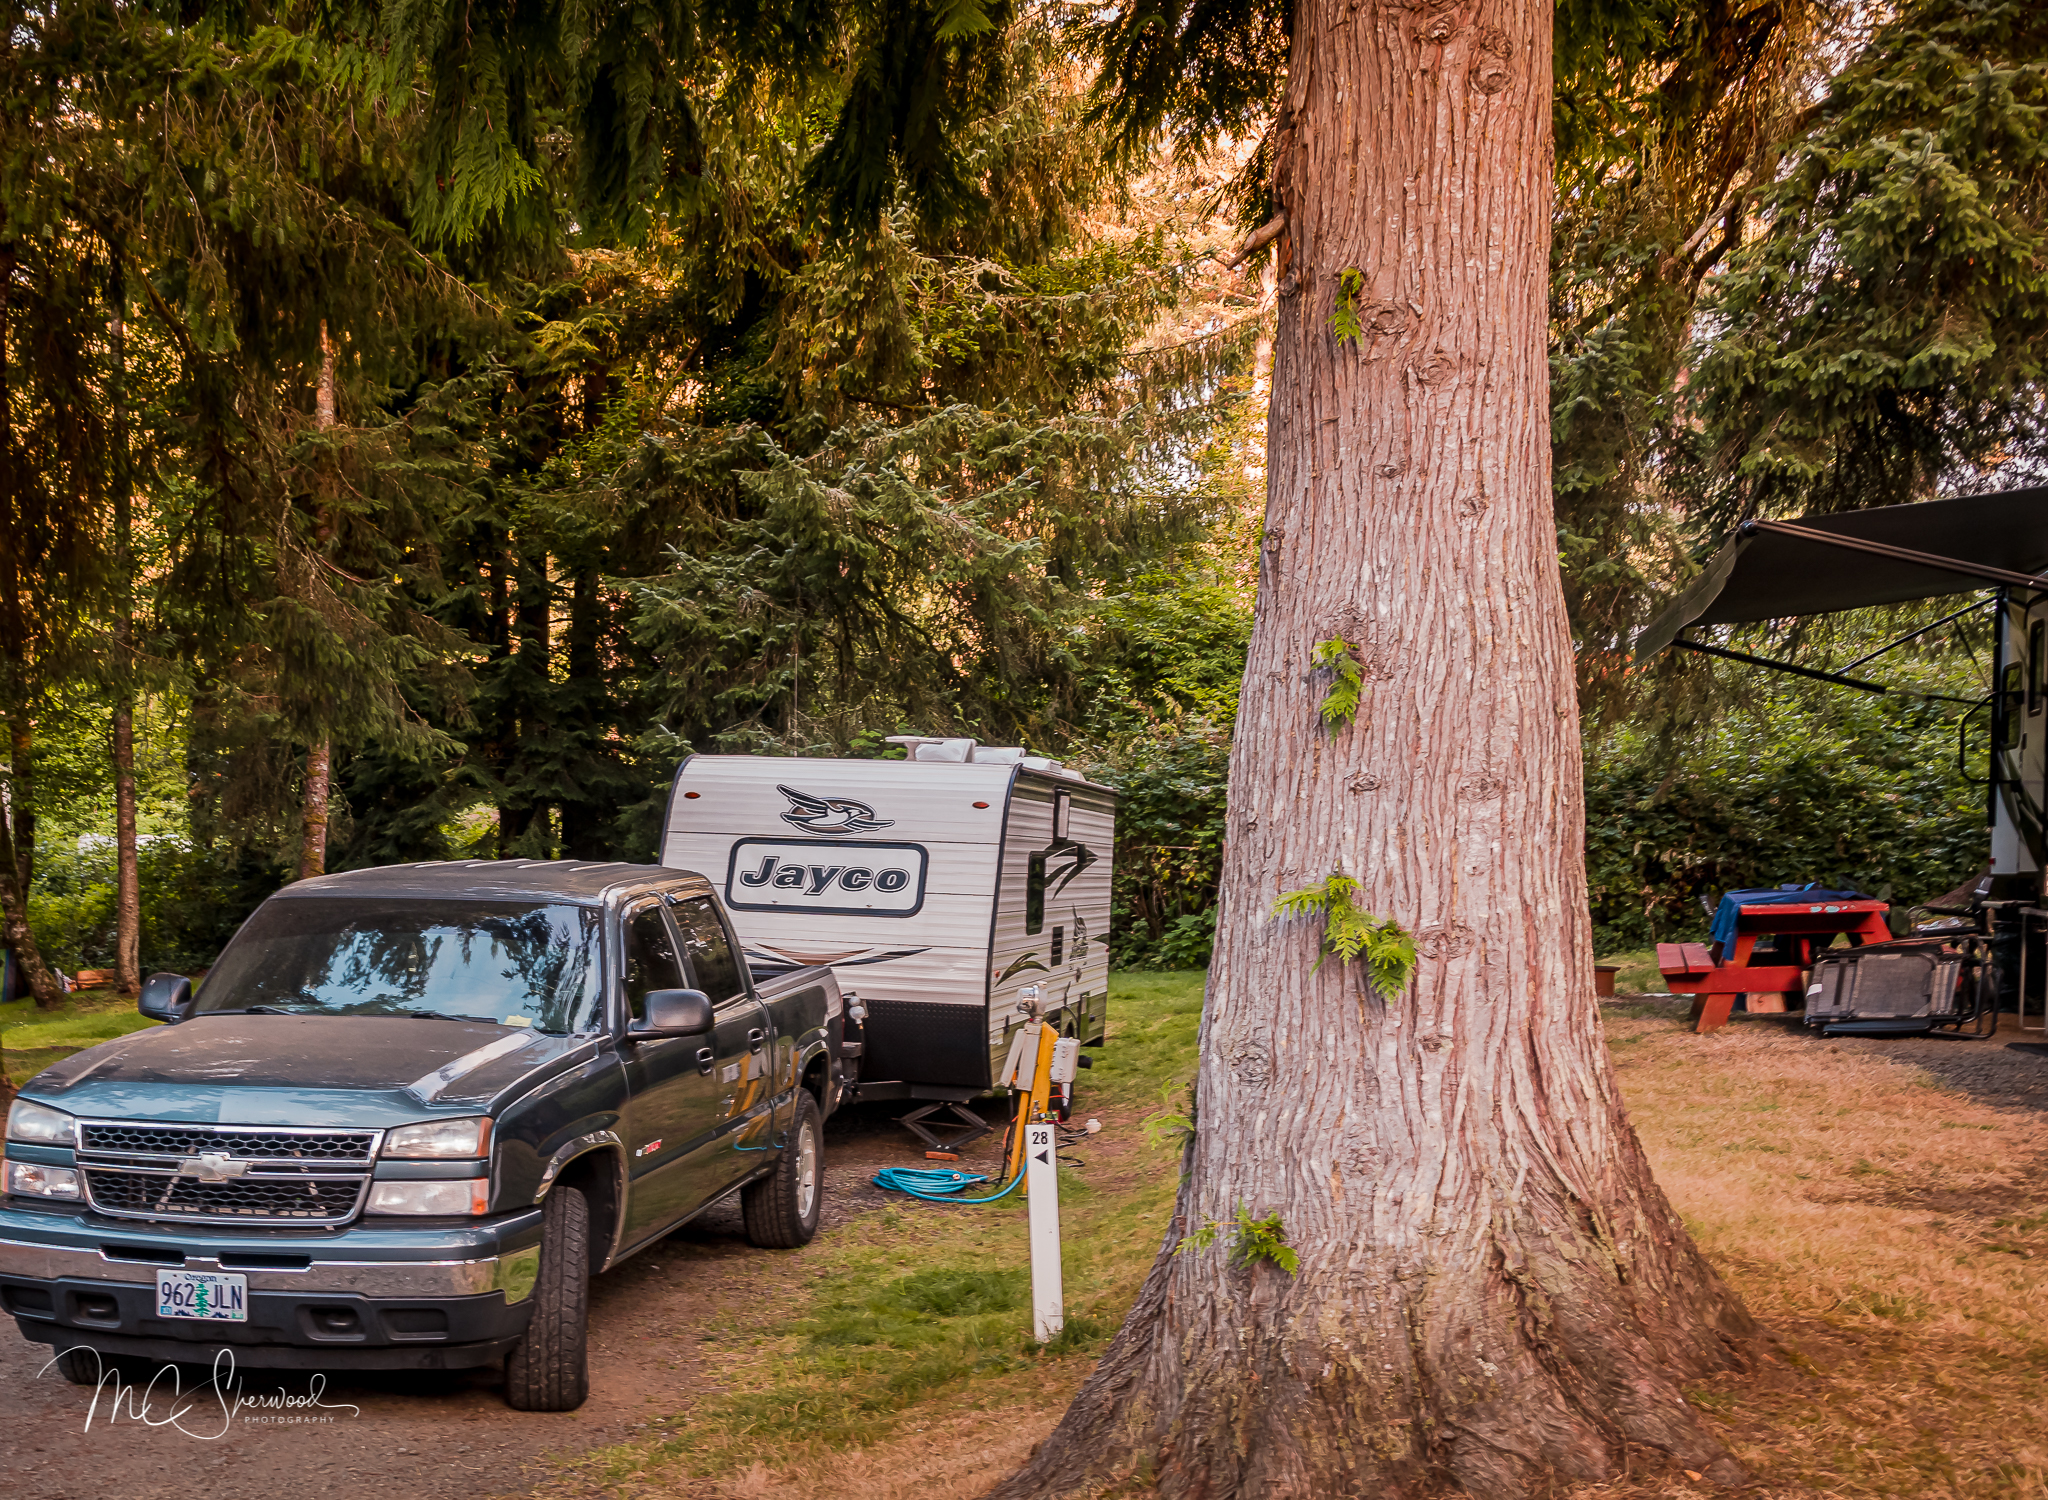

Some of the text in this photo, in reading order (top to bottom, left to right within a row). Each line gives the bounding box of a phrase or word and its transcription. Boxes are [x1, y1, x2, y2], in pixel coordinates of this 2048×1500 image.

[740, 855, 911, 896] Jayco
[1032, 1131, 1048, 1145] 28
[184, 1273, 218, 1284] Oregon
[161, 1281, 242, 1310] 962 JLN
